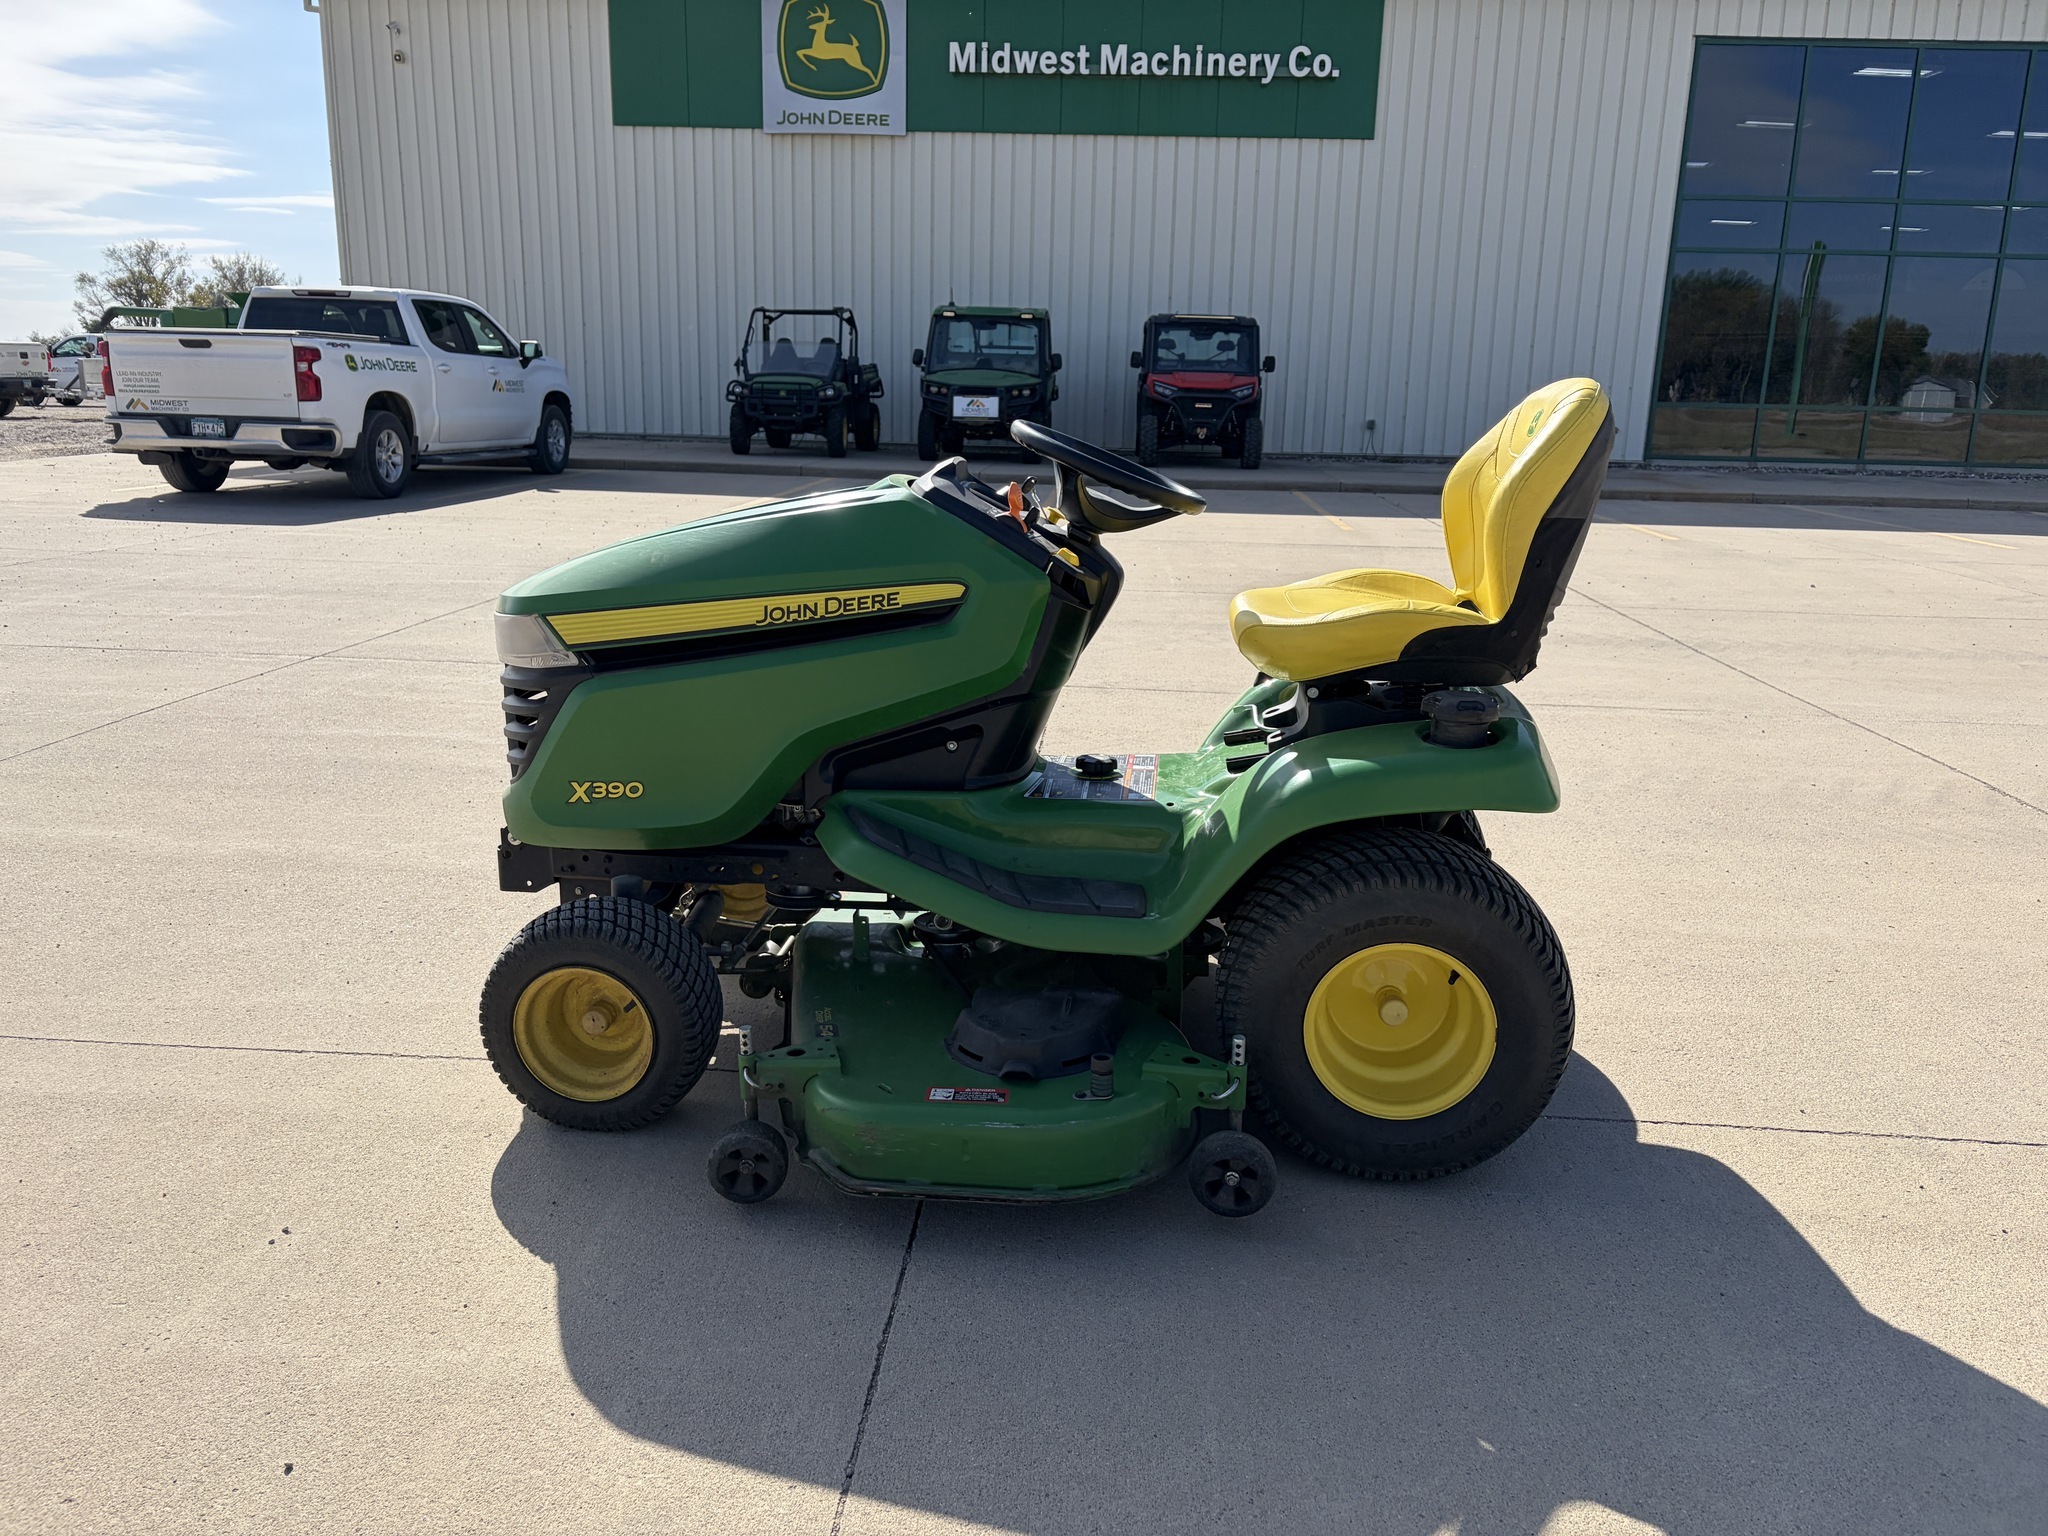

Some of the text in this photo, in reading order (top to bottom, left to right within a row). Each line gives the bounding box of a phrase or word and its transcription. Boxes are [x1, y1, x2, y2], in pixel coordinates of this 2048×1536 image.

[948, 41, 1340, 84] Midwest Machinery Co.
[776, 109, 890, 127] JOHN DEERE
[360, 355, 418, 372] JOHN DEERE
[150, 399, 189, 407] MIDWEST
[755, 591, 901, 625] JOHN DEERE
[567, 781, 644, 803] X390
[1296, 914, 1434, 971] TURF MASTER
